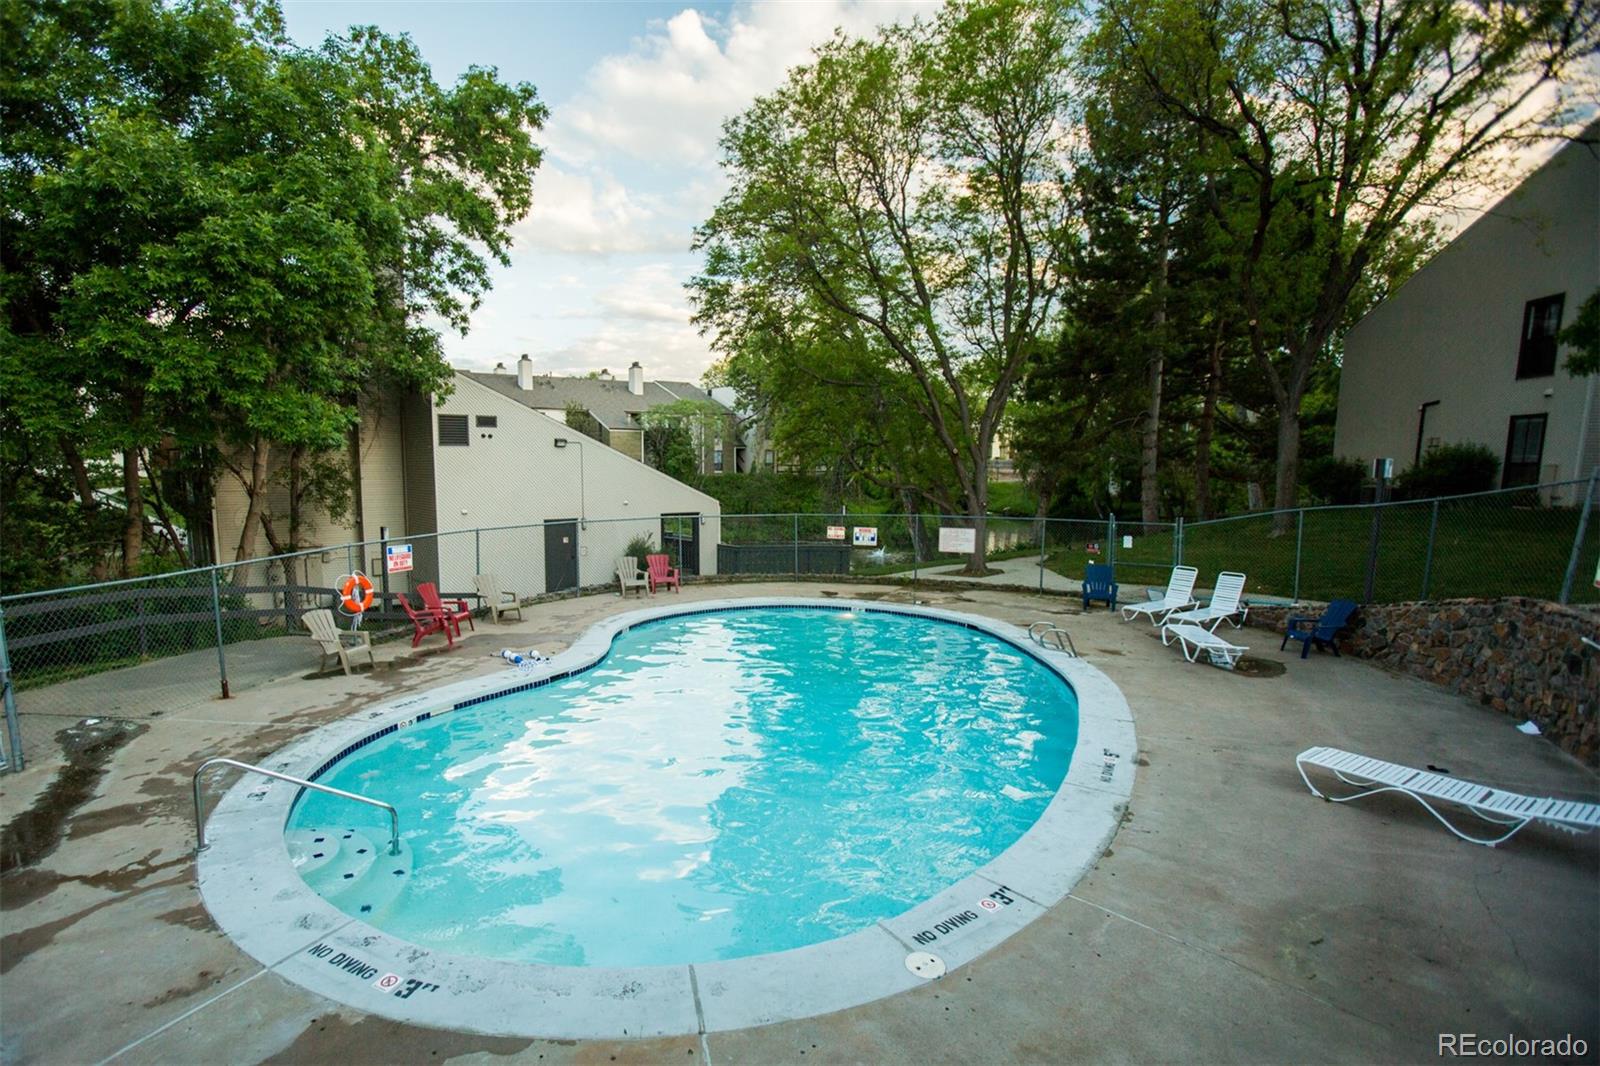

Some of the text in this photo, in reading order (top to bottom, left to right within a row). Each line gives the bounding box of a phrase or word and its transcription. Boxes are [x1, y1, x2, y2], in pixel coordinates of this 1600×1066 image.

[912, 930, 938, 946] NO
[934, 910, 979, 935] DIVING
[308, 943, 333, 959] NO
[328, 952, 378, 980] DIVING
